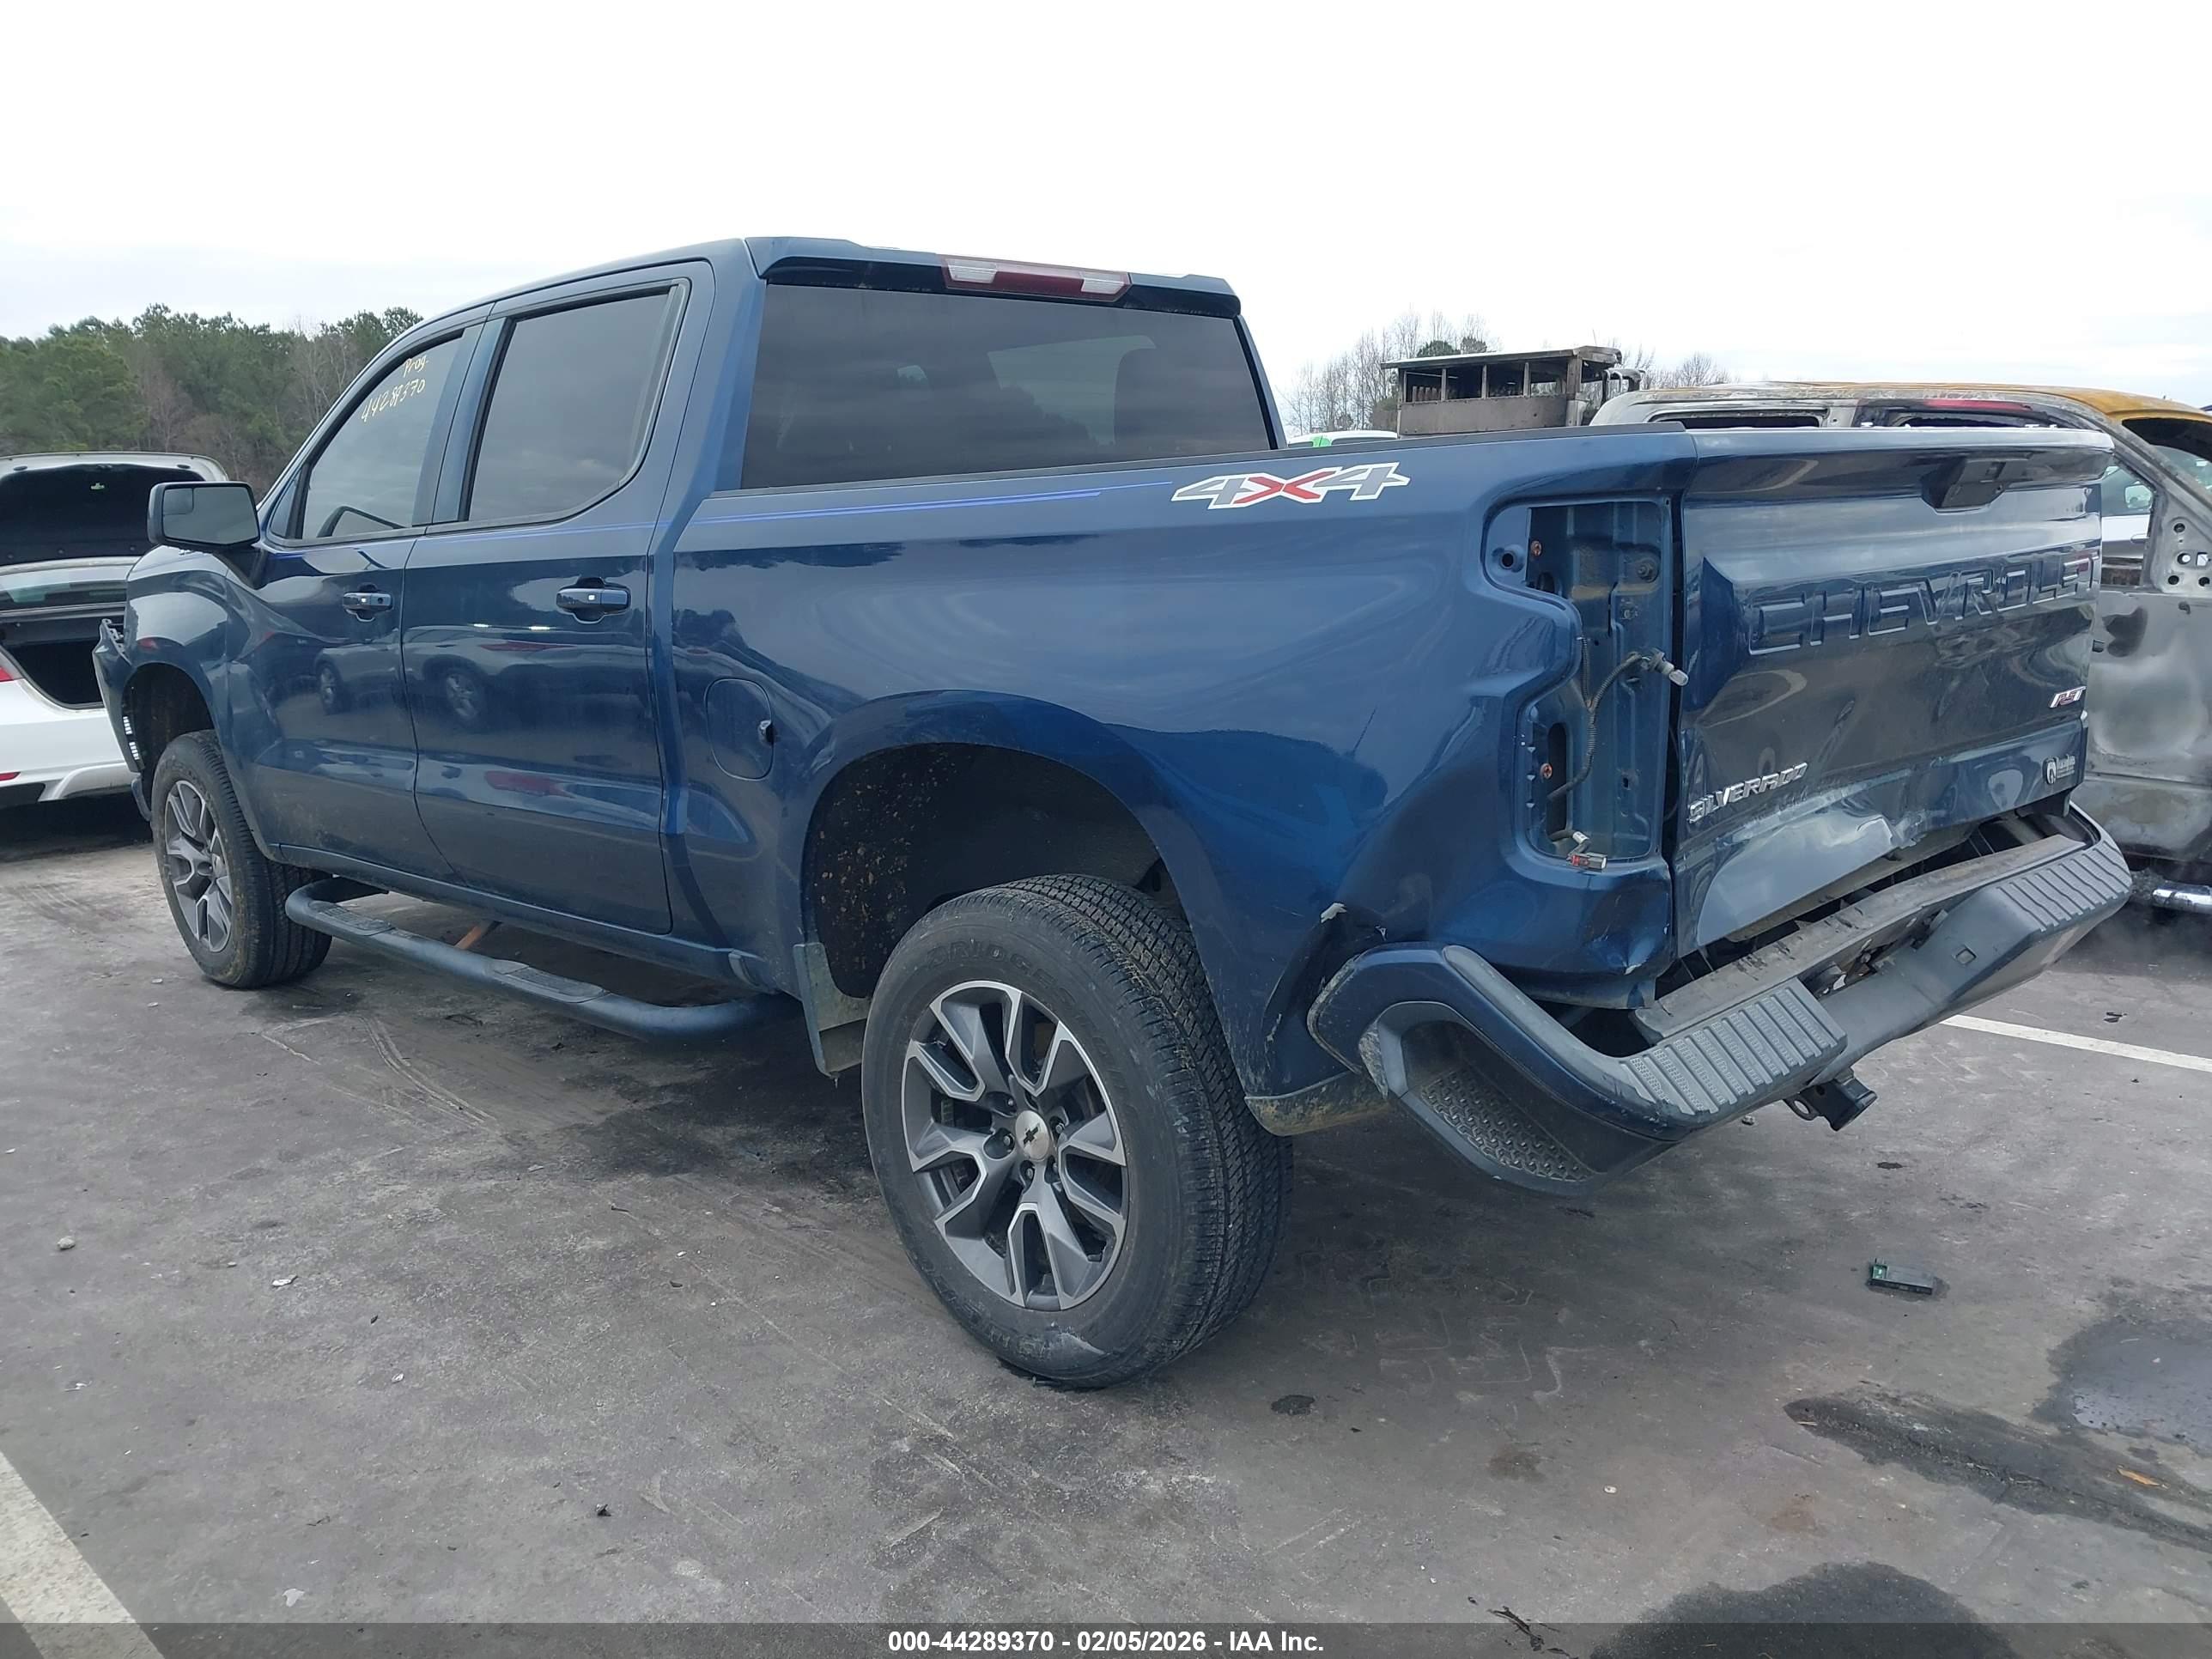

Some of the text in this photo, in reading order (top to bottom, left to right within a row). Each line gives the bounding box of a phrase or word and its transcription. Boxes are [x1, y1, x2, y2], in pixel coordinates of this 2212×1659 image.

[361, 379, 426, 422] 44289370
[1747, 551, 2100, 656] CHEVROLET
[2050, 686, 2087, 708] RST
[1687, 762, 1808, 824] SILVERADO
